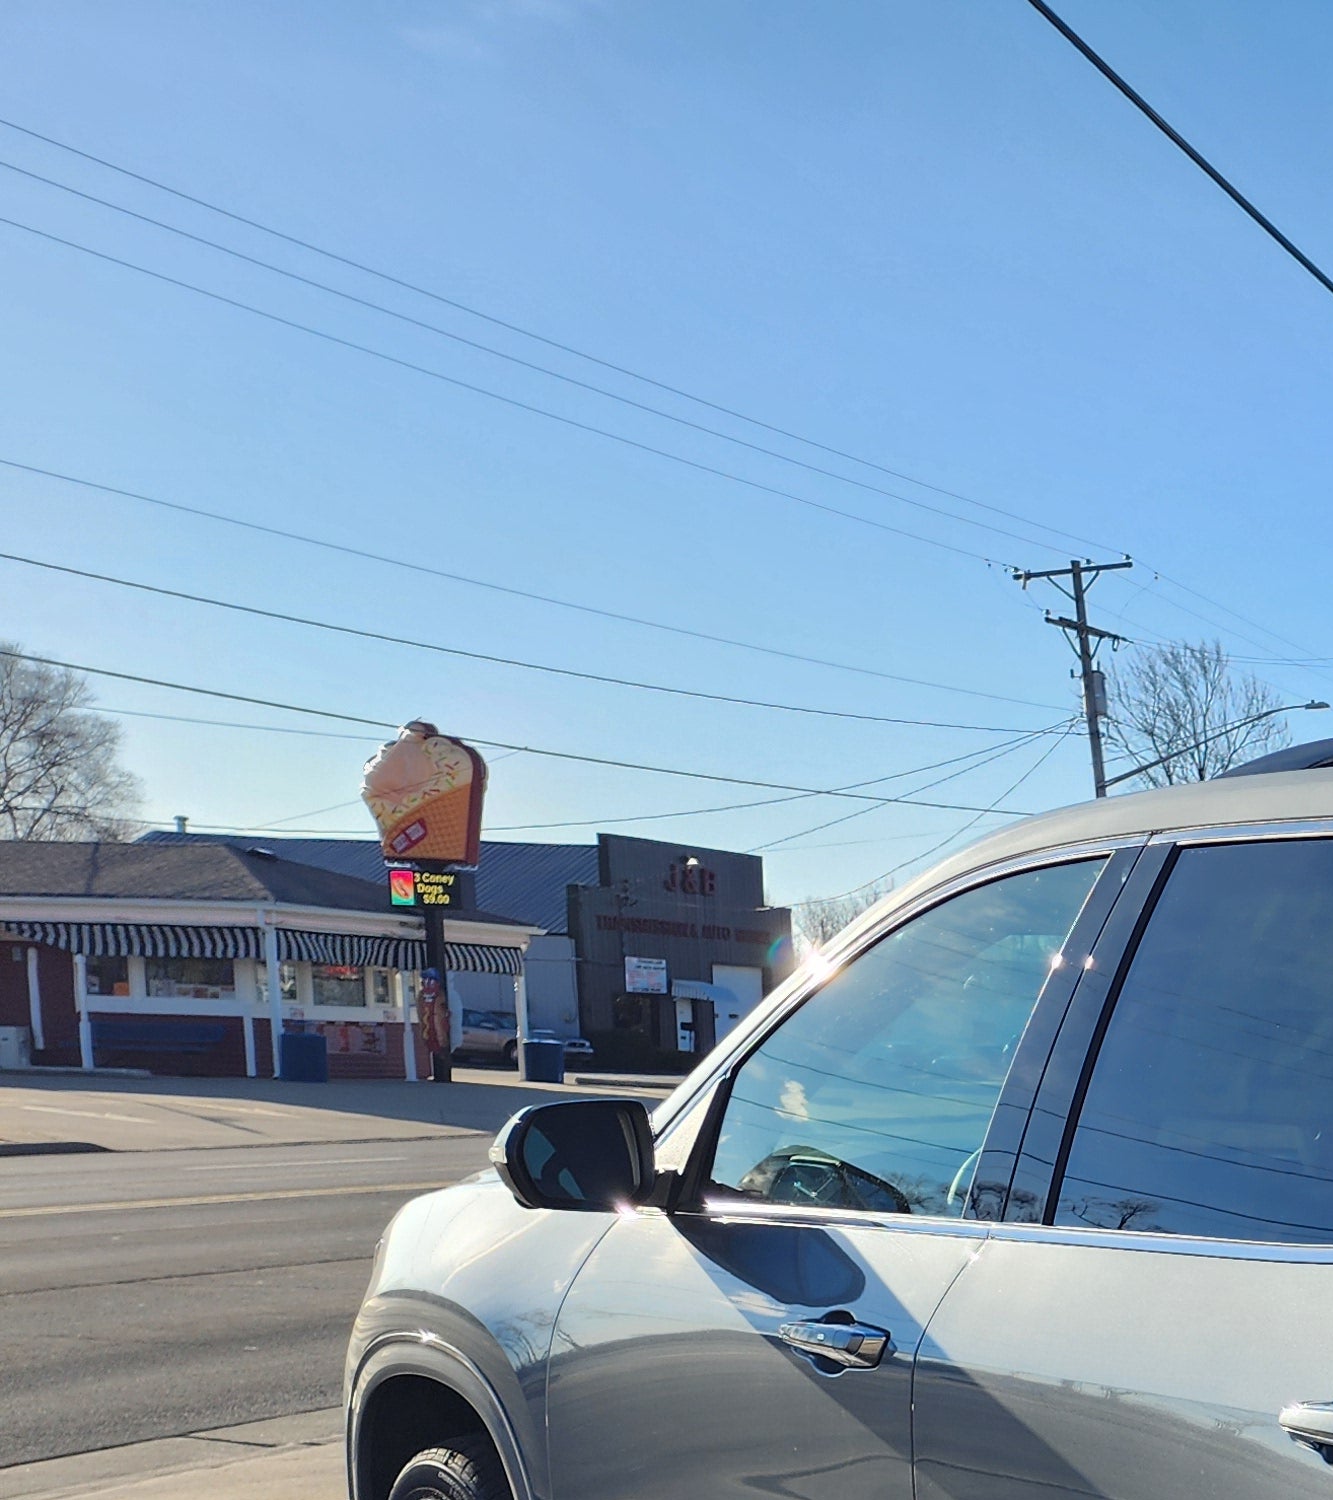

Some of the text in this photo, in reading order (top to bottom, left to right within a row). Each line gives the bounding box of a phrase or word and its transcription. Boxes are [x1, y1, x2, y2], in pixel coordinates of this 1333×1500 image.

[413, 872, 454, 886] 3 Coney
[417, 883, 443, 895] Dogs
[423, 894, 450, 905] $9.00
